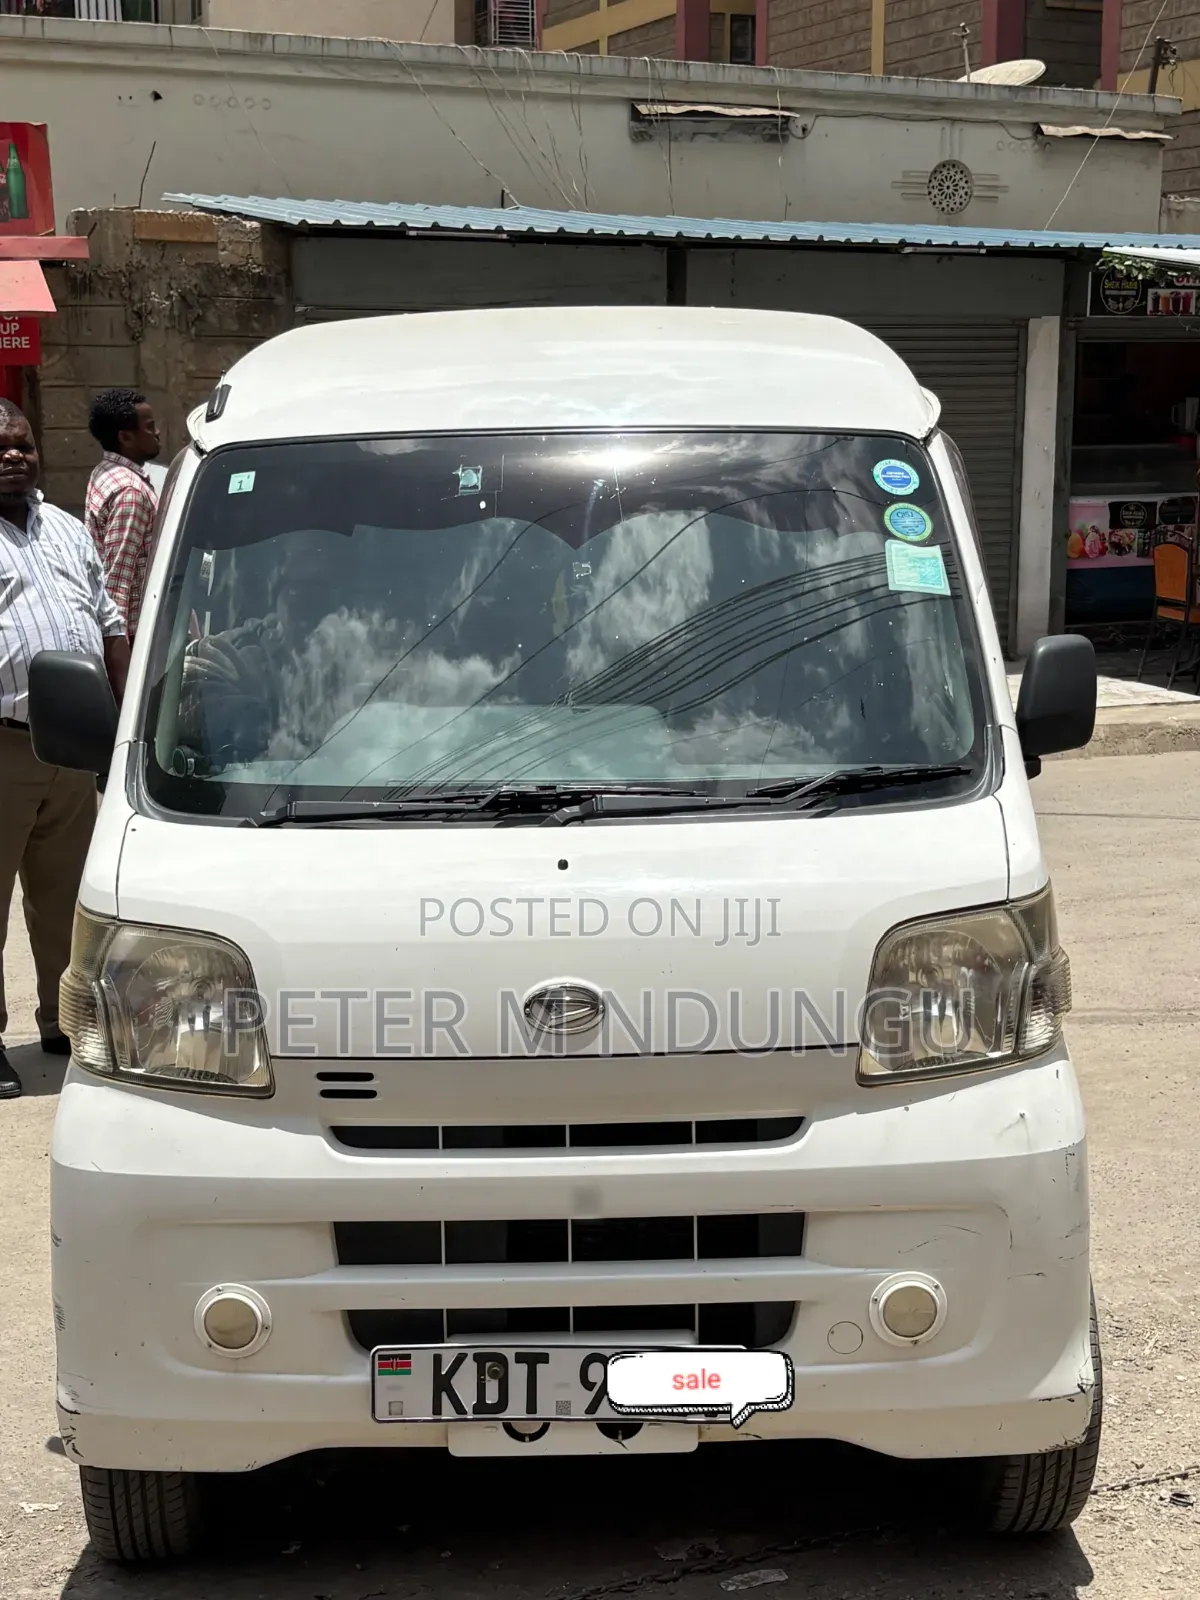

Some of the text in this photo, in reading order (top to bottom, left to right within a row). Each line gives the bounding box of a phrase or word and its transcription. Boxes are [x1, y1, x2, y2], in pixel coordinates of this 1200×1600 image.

[0, 336, 30, 349] ERE
[236, 480, 243, 491] 1
[432, 1352, 550, 1415] KDT
